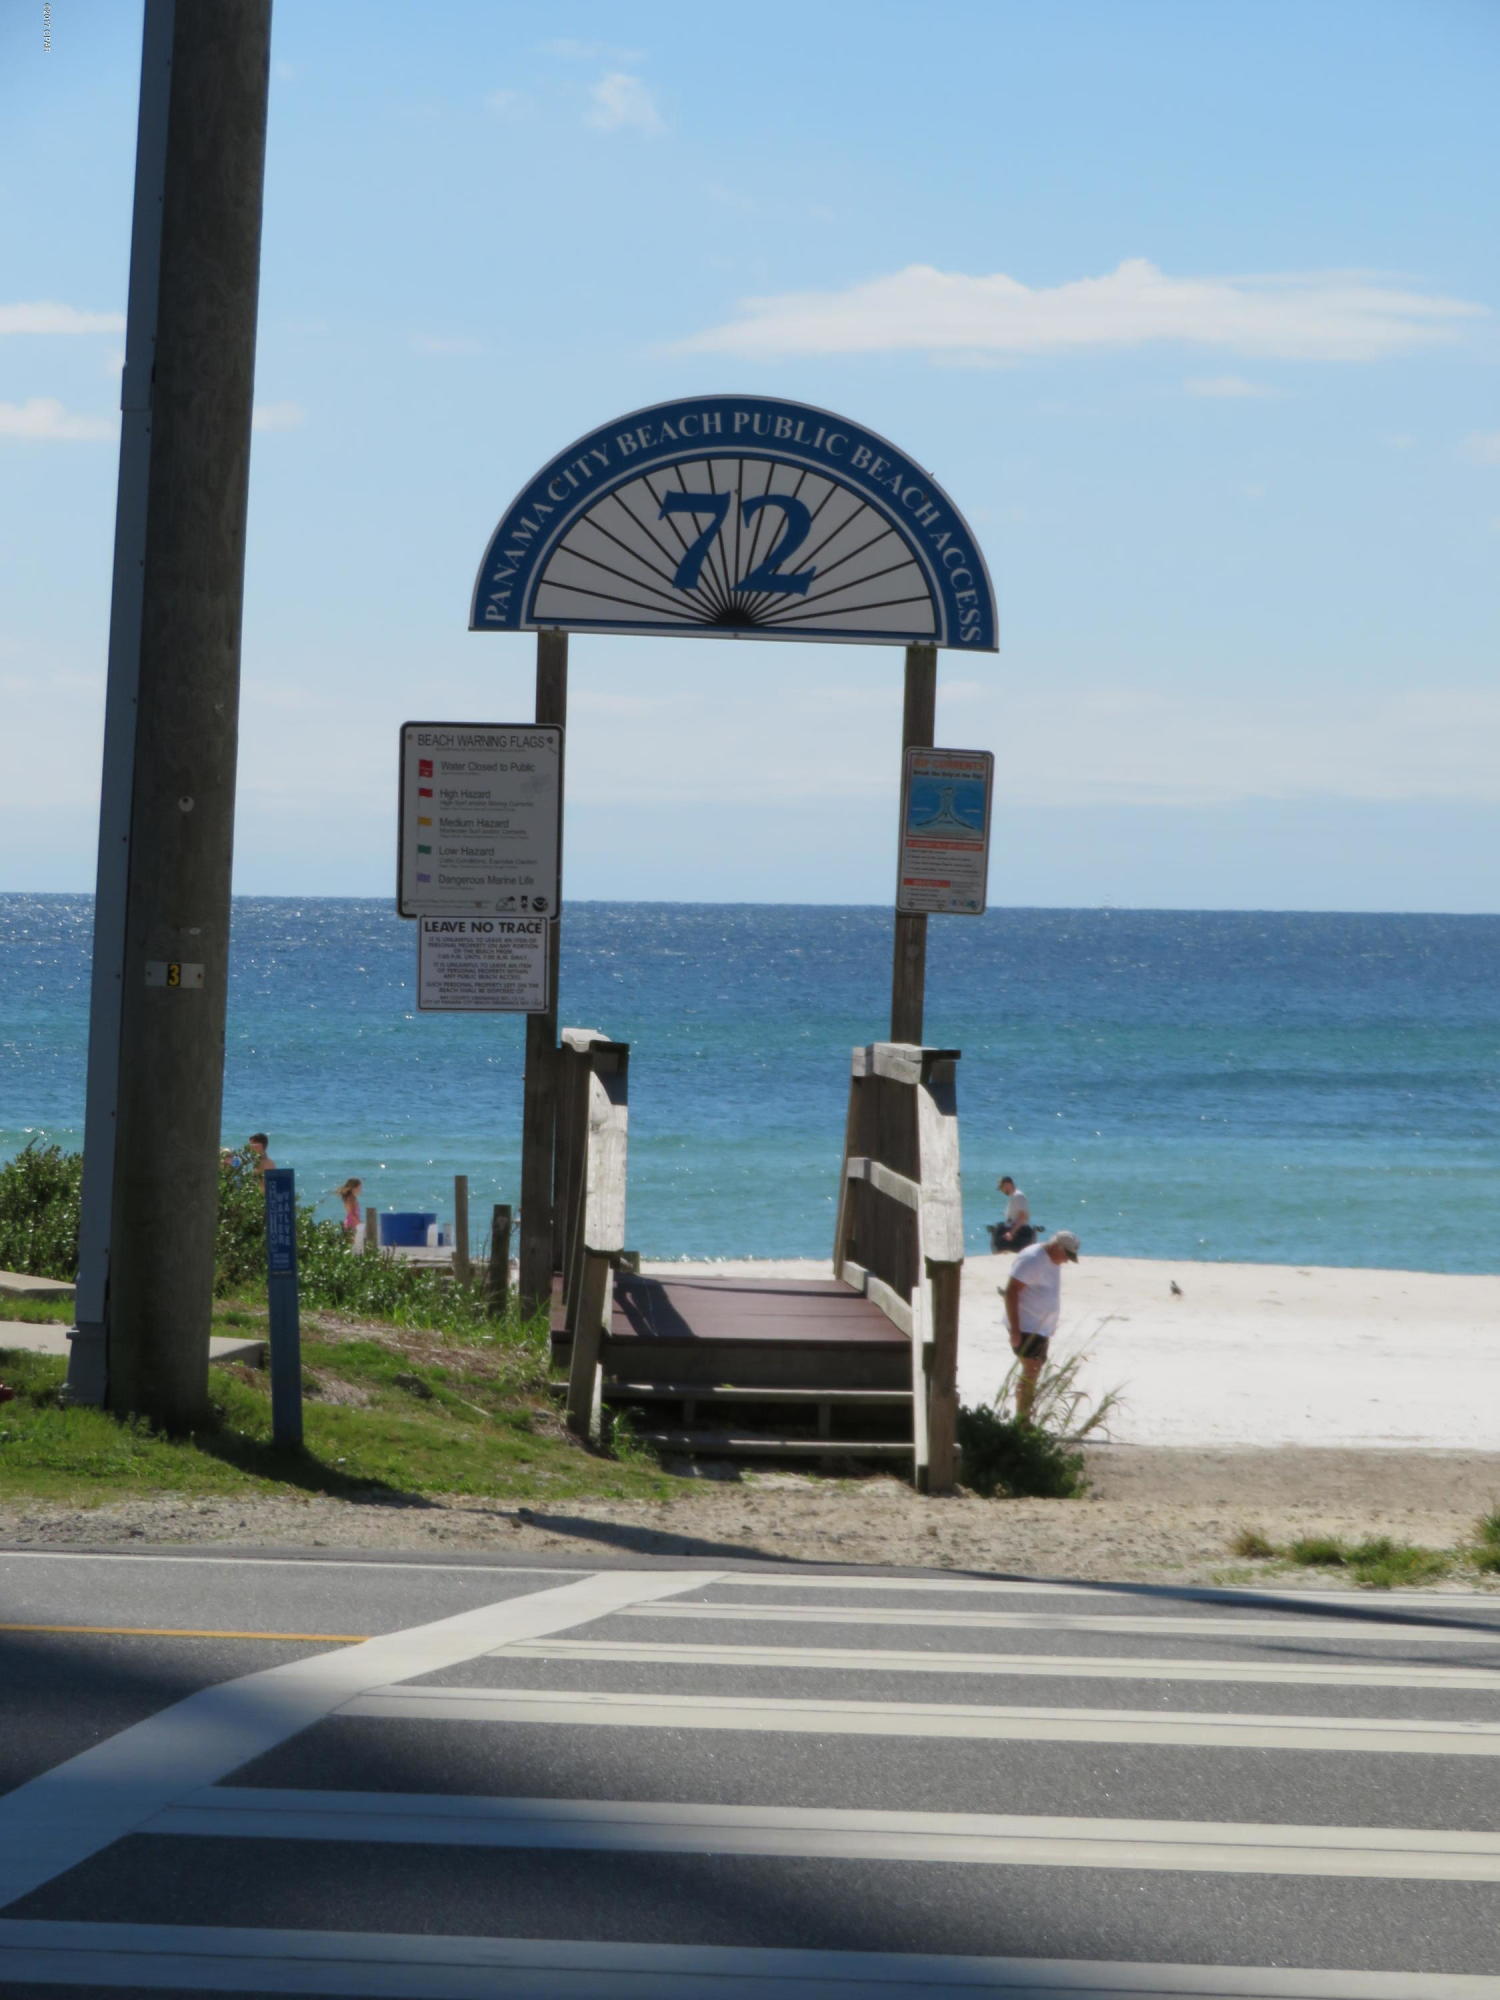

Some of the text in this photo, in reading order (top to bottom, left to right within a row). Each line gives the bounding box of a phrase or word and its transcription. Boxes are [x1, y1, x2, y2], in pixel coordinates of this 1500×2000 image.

[615, 412, 723, 457] BEACH
[734, 411, 849, 457] PUBLIC
[850, 444, 941, 528] BEACH
[929, 531, 982, 643] ACCESS
[657, 489, 817, 597] 72
[417, 734, 545, 749] BEACH WARNING FLAGS
[440, 761, 536, 772] Water Closed to Public
[439, 790, 491, 800] High Hazard
[439, 818, 509, 829] Medium Hazard
[438, 846, 495, 857] Low Hazard
[438, 874, 534, 888] Dangerous Marine Life
[424, 921, 543, 934] LEAVE NO TRACE
[169, 964, 179, 985] 3
